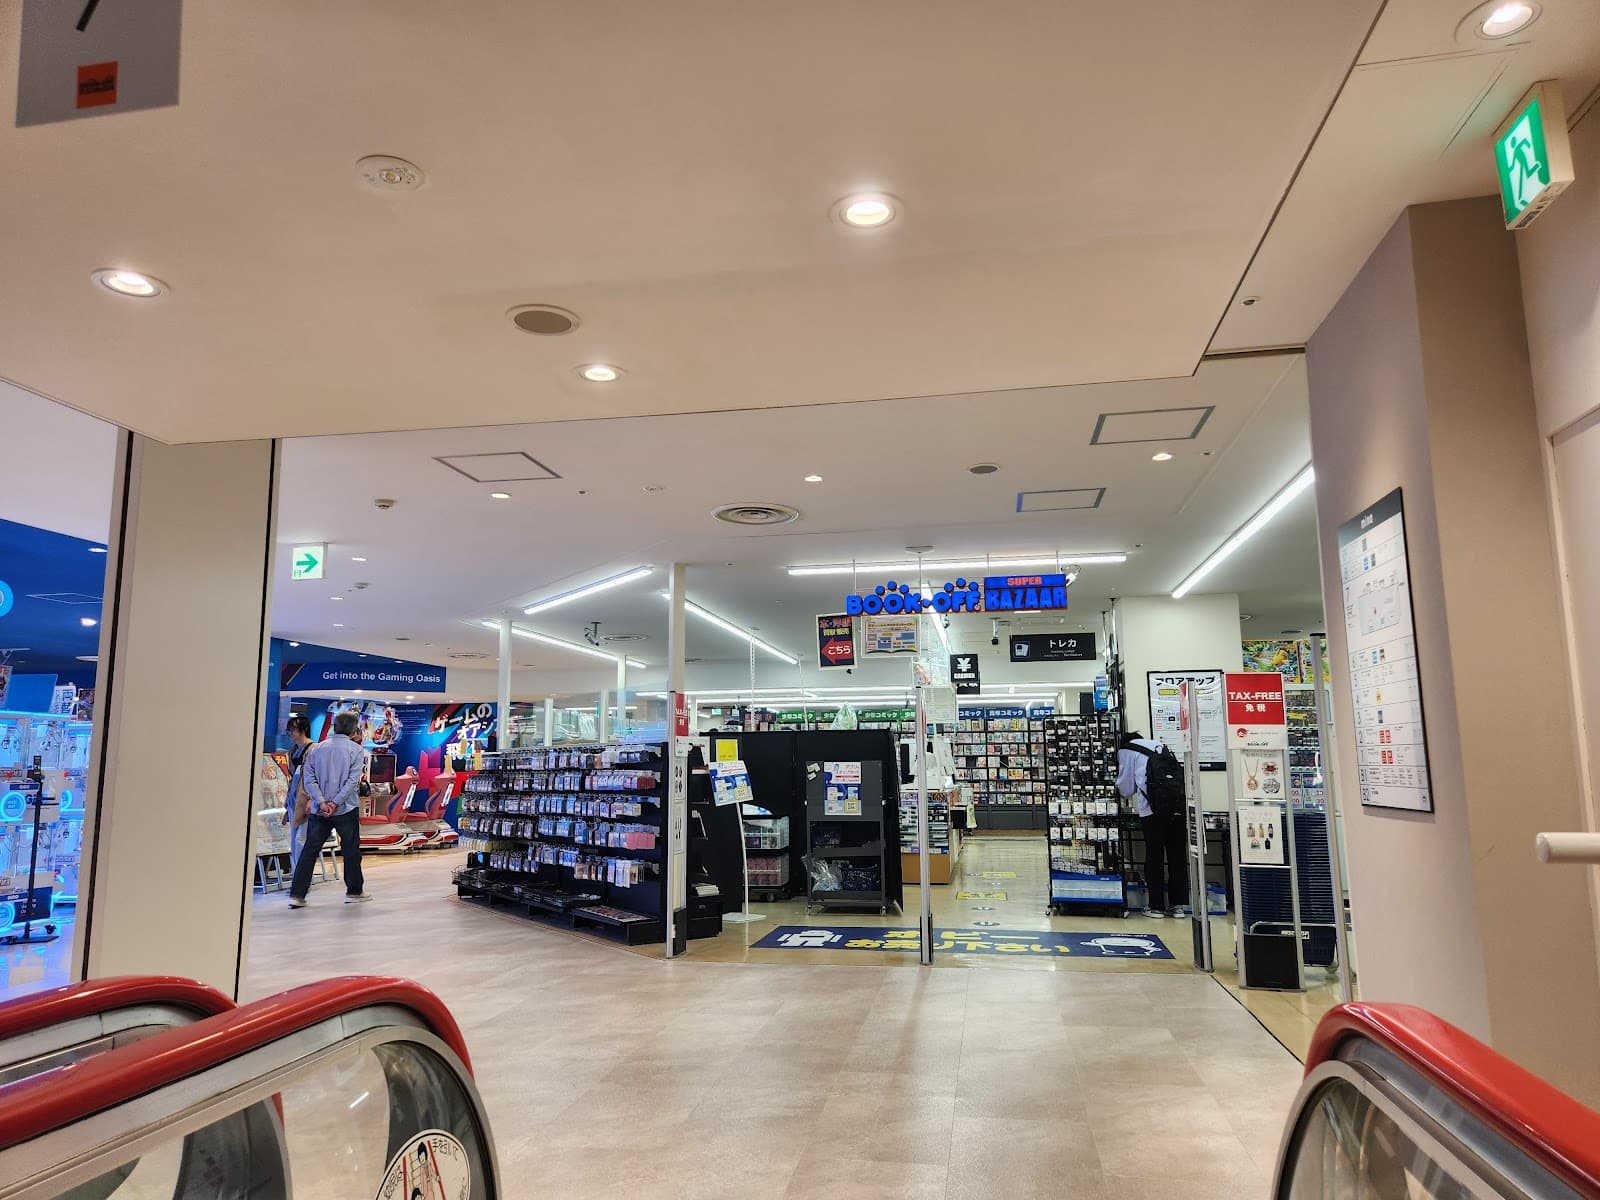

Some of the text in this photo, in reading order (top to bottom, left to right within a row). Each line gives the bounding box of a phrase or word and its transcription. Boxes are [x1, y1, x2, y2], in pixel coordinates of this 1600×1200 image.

[1007, 576, 1042, 586] SUPER
[846, 590, 981, 616] BOOK-OFF
[986, 587, 1067, 609] BAZAAR
[828, 645, 851, 655] こちら
[1049, 639, 1077, 648] トレカ
[323, 671, 441, 684] Get into the Gaming Oasis
[1228, 691, 1282, 700] TAX-FREE
[435, 703, 493, 733] ゲームの
[456, 718, 498, 740] オアシ
